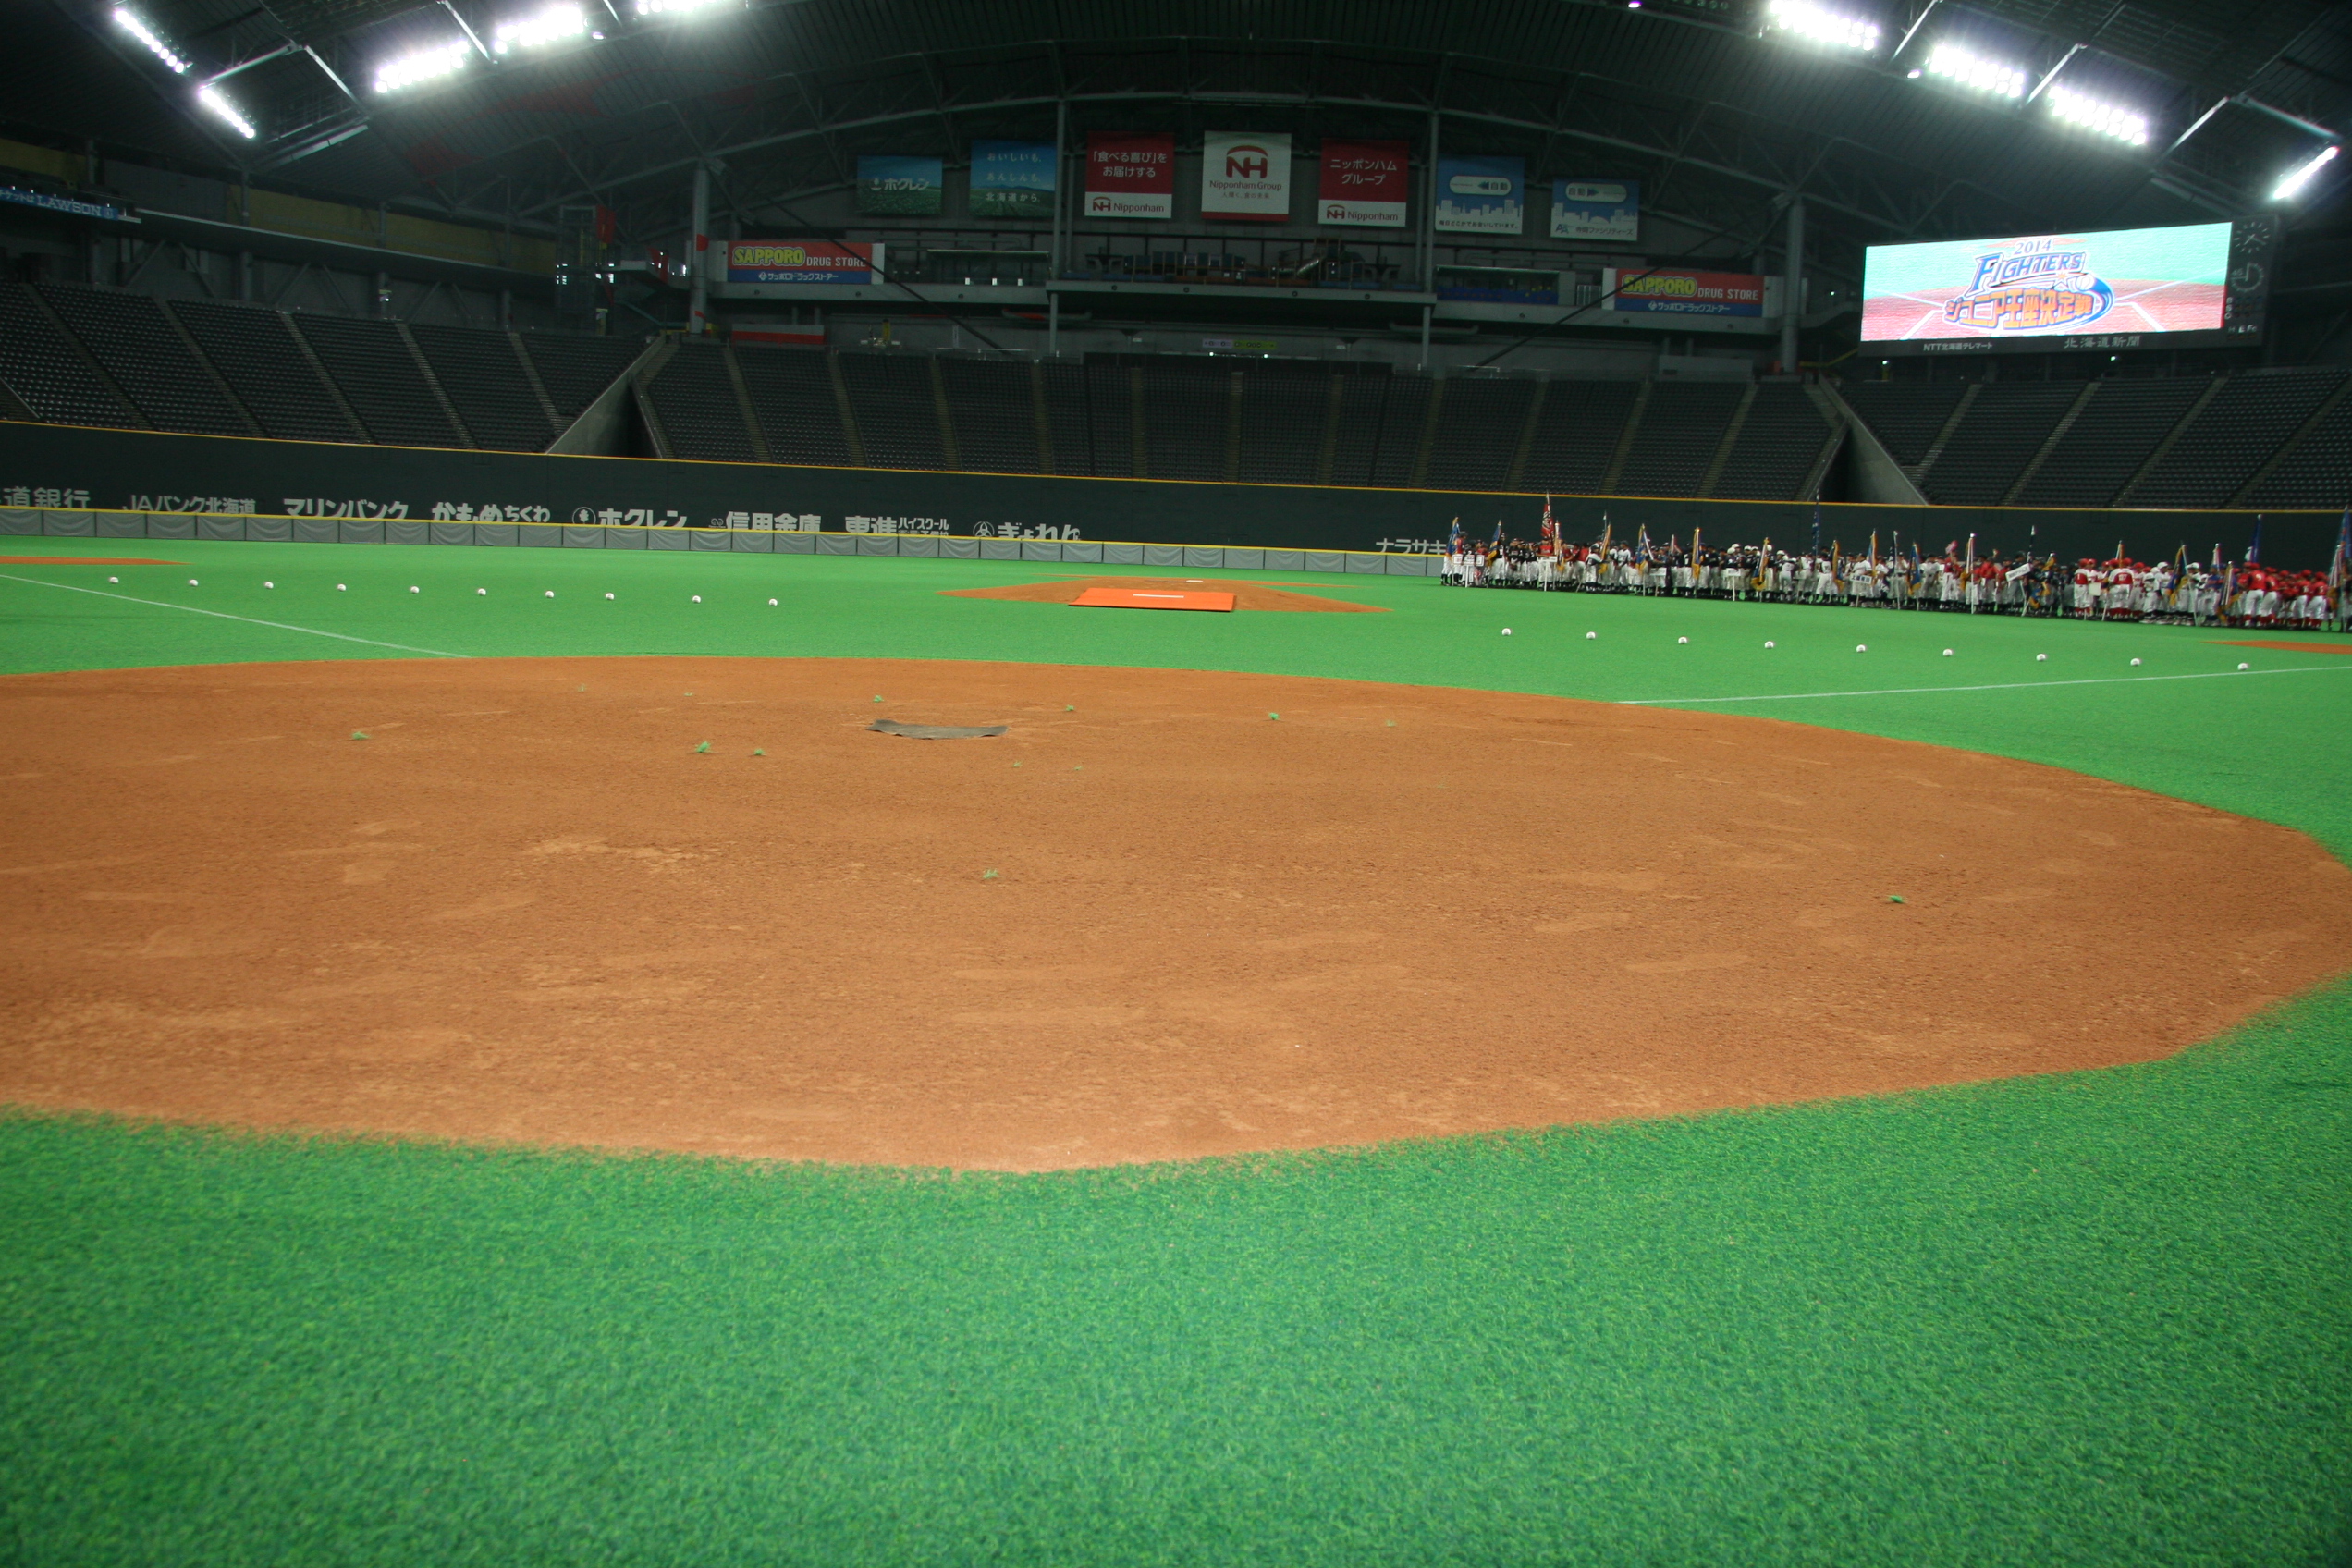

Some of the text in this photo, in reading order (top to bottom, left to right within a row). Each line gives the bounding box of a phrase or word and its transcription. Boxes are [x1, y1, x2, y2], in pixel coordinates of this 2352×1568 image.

[1094, 151, 1167, 164] 「食べる喜び」を
[1330, 159, 1398, 171] ニッポンハム
[1103, 165, 1156, 178] お届けする
[1226, 155, 1268, 179] NH
[884, 178, 930, 191] ホクレン
[1209, 180, 1282, 192] Nipponham Group
[1341, 173, 1387, 186] グループ
[37, 194, 102, 217] LAWSON
[1113, 202, 1164, 214] Nipponham
[1347, 211, 1399, 222] Nipponham
[2014, 239, 2052, 255] 2014
[733, 246, 806, 266] SAPPORO
[806, 257, 832, 267] DRUG
[1966, 253, 2085, 296] FIGHTERS
[1622, 275, 1759, 300] SAPPORO DRUG STORE
[2064, 335, 2141, 350] 北海道新聞
[122, 494, 256, 515] JAバンク北海道
[283, 498, 410, 520] マリンバンク
[598, 508, 689, 529] ホクレン
[726, 510, 822, 532] 信用金庫
